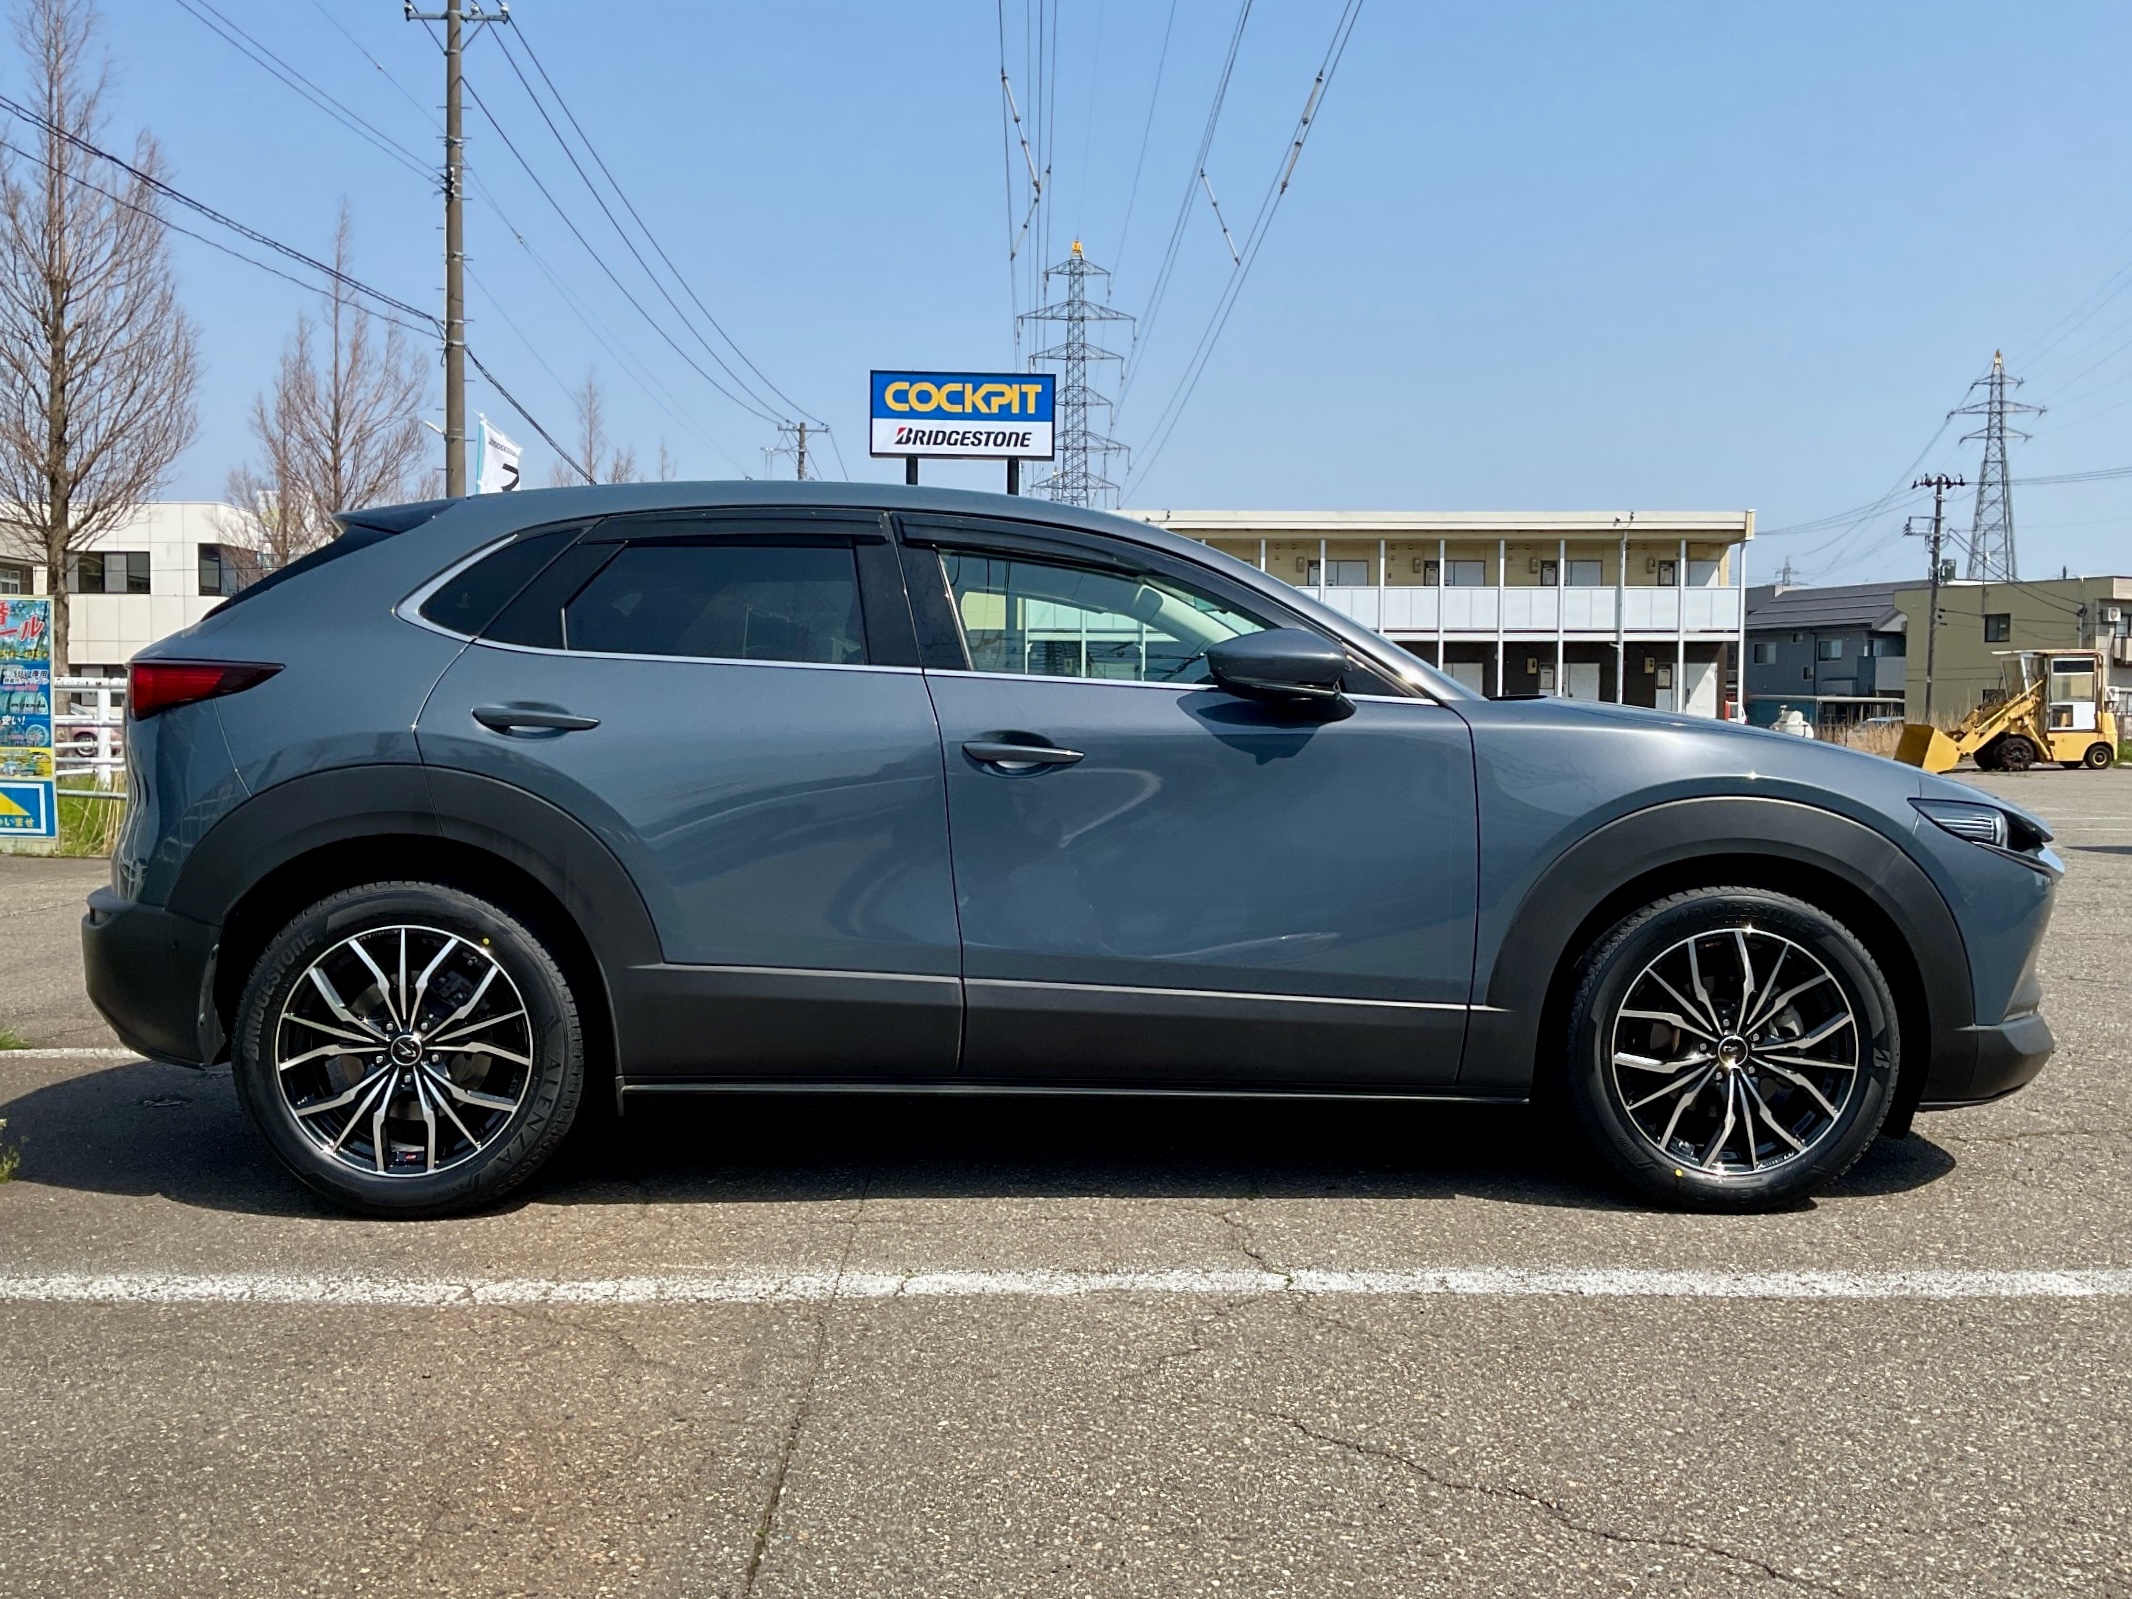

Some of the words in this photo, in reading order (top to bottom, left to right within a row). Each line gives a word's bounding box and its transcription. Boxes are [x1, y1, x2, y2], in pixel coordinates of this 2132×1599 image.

[884, 381, 1042, 414] COCKPIT
[894, 427, 1032, 447] BRIDGESTONE
[495, 1055, 564, 1165] ALENZA
